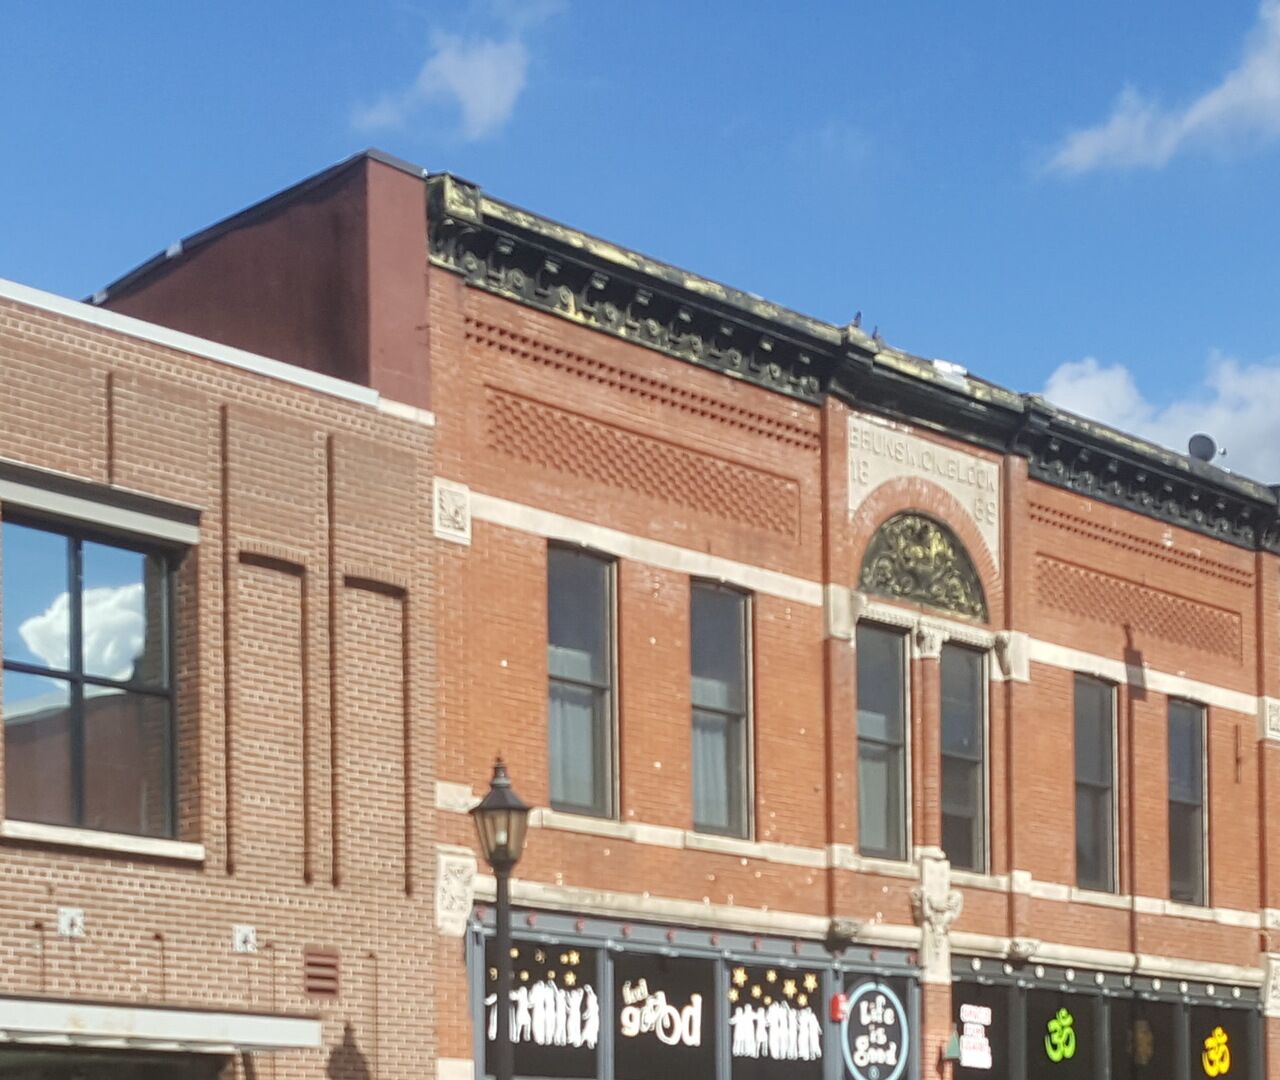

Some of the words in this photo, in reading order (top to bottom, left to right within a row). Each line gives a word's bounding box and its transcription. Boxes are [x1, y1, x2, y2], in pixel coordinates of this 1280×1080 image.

[860, 994, 895, 1026] Life
[868, 1023, 888, 1046] is
[853, 1034, 897, 1068] good
